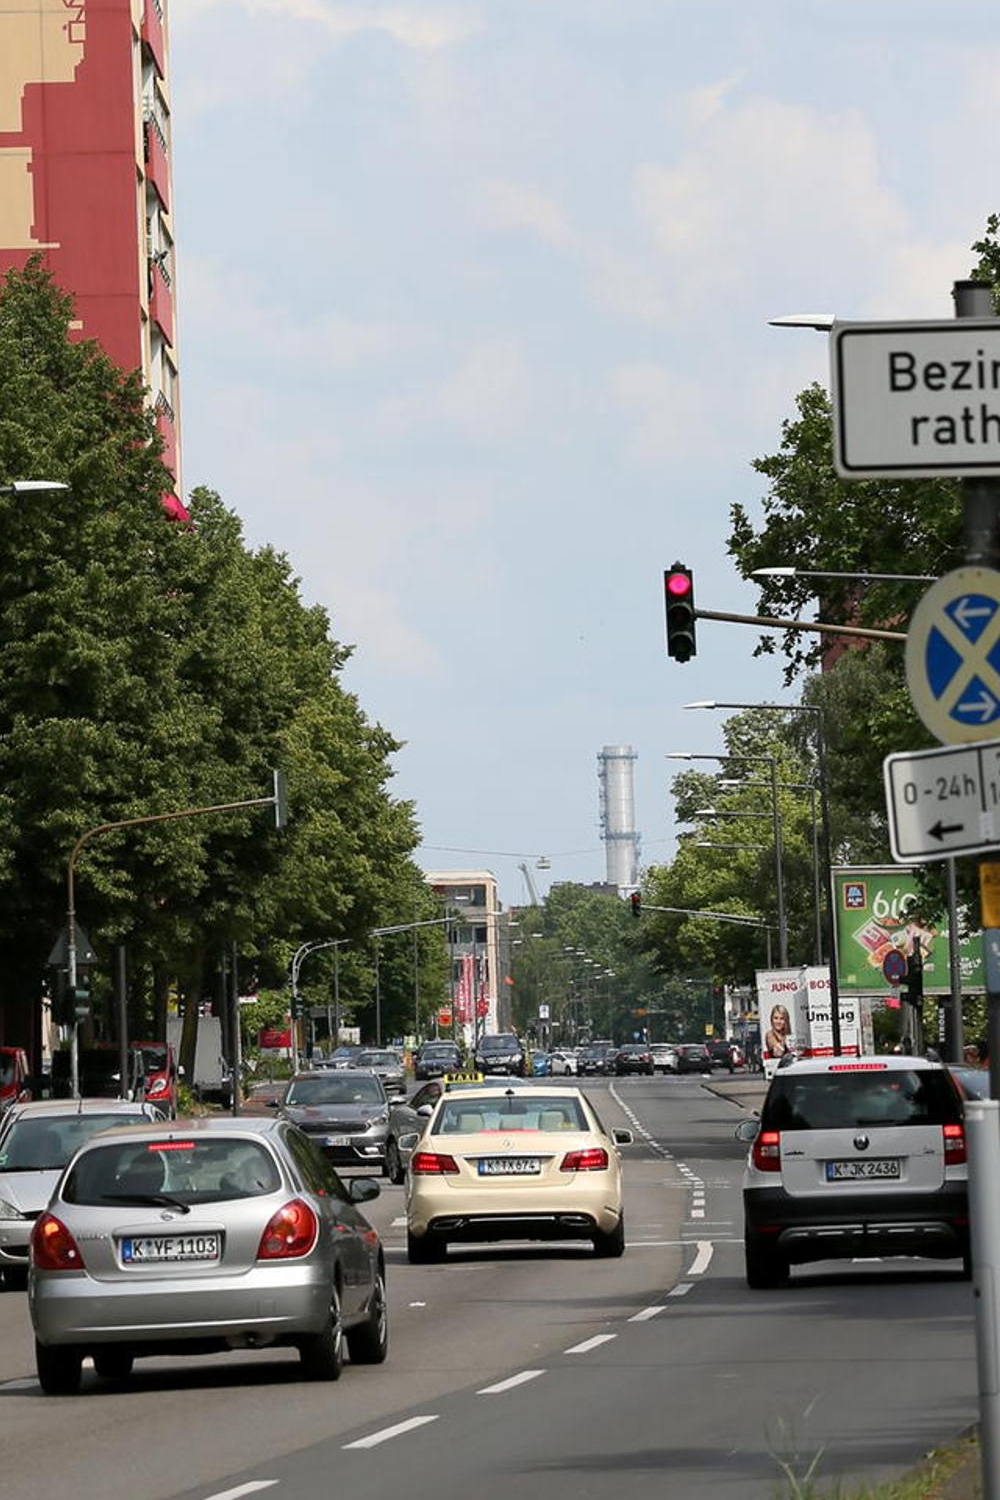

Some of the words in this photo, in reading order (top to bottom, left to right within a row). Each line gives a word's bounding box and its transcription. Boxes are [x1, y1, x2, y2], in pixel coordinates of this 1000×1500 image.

[911, 403, 1000, 446] rath
[806, 1010, 855, 1024] Umug
[834, 1164, 843, 1176] K
[132, 1240, 142, 1256] K
[153, 1239, 174, 1255] YF
[177, 1237, 216, 1254] 1103
